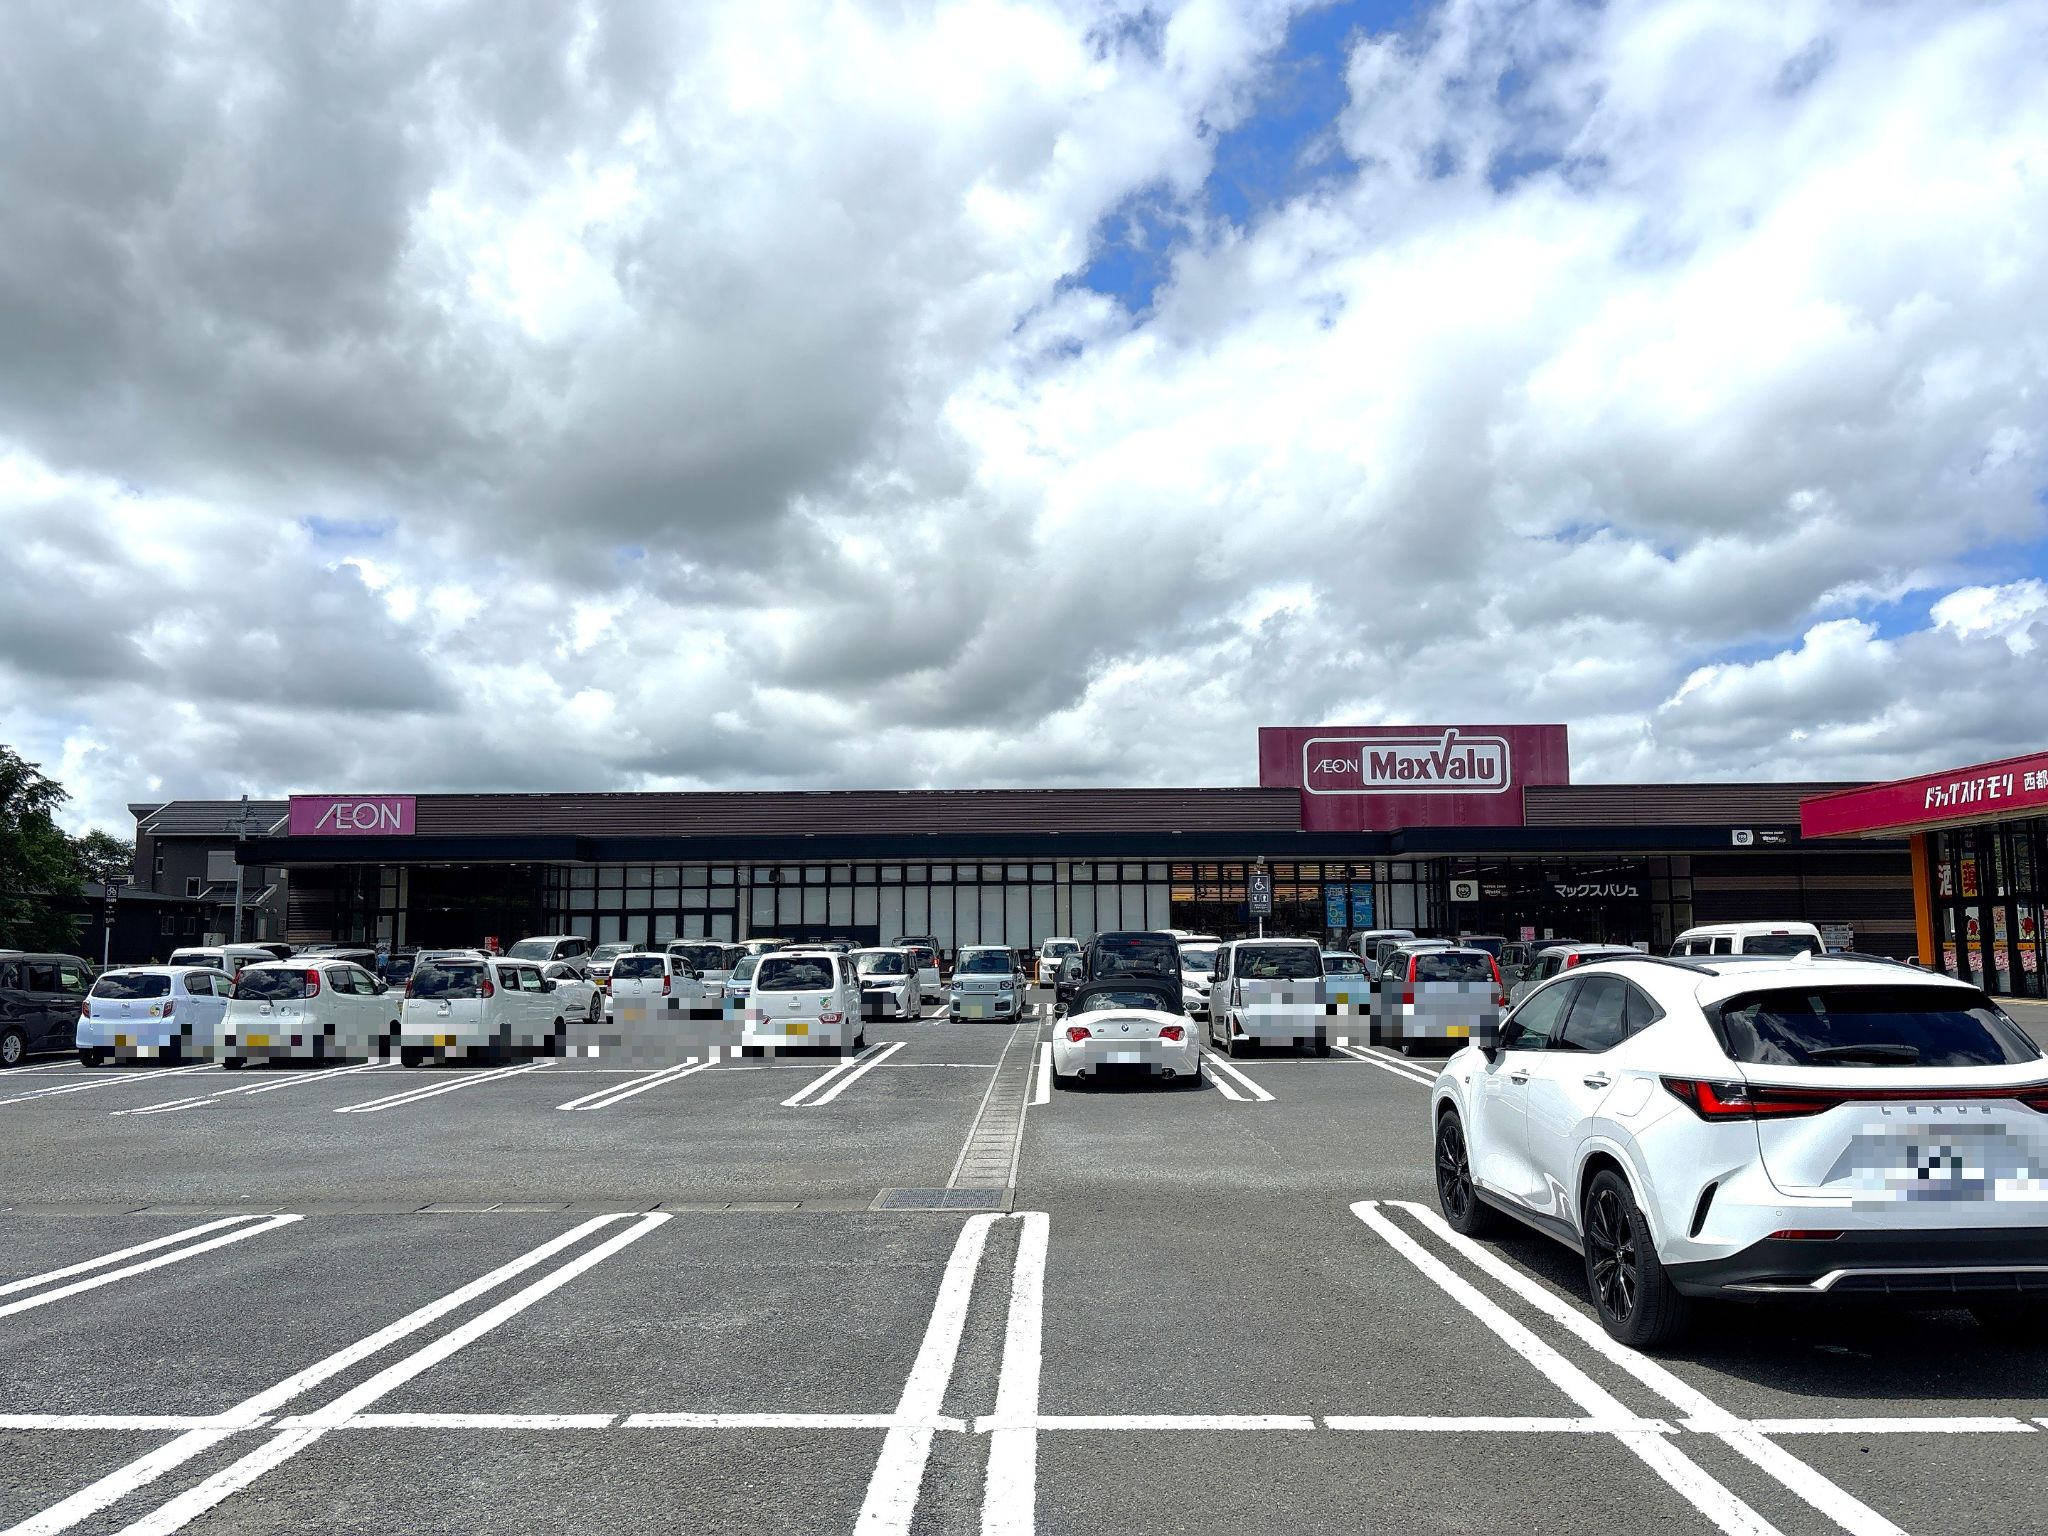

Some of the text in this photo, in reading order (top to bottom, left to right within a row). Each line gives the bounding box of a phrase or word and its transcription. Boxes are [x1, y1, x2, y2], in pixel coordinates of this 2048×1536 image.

[1370, 732, 1494, 780] MaxValu
[1924, 773, 2014, 809] ドラッグストアモリ
[1554, 884, 1640, 898] マックスバリュ
